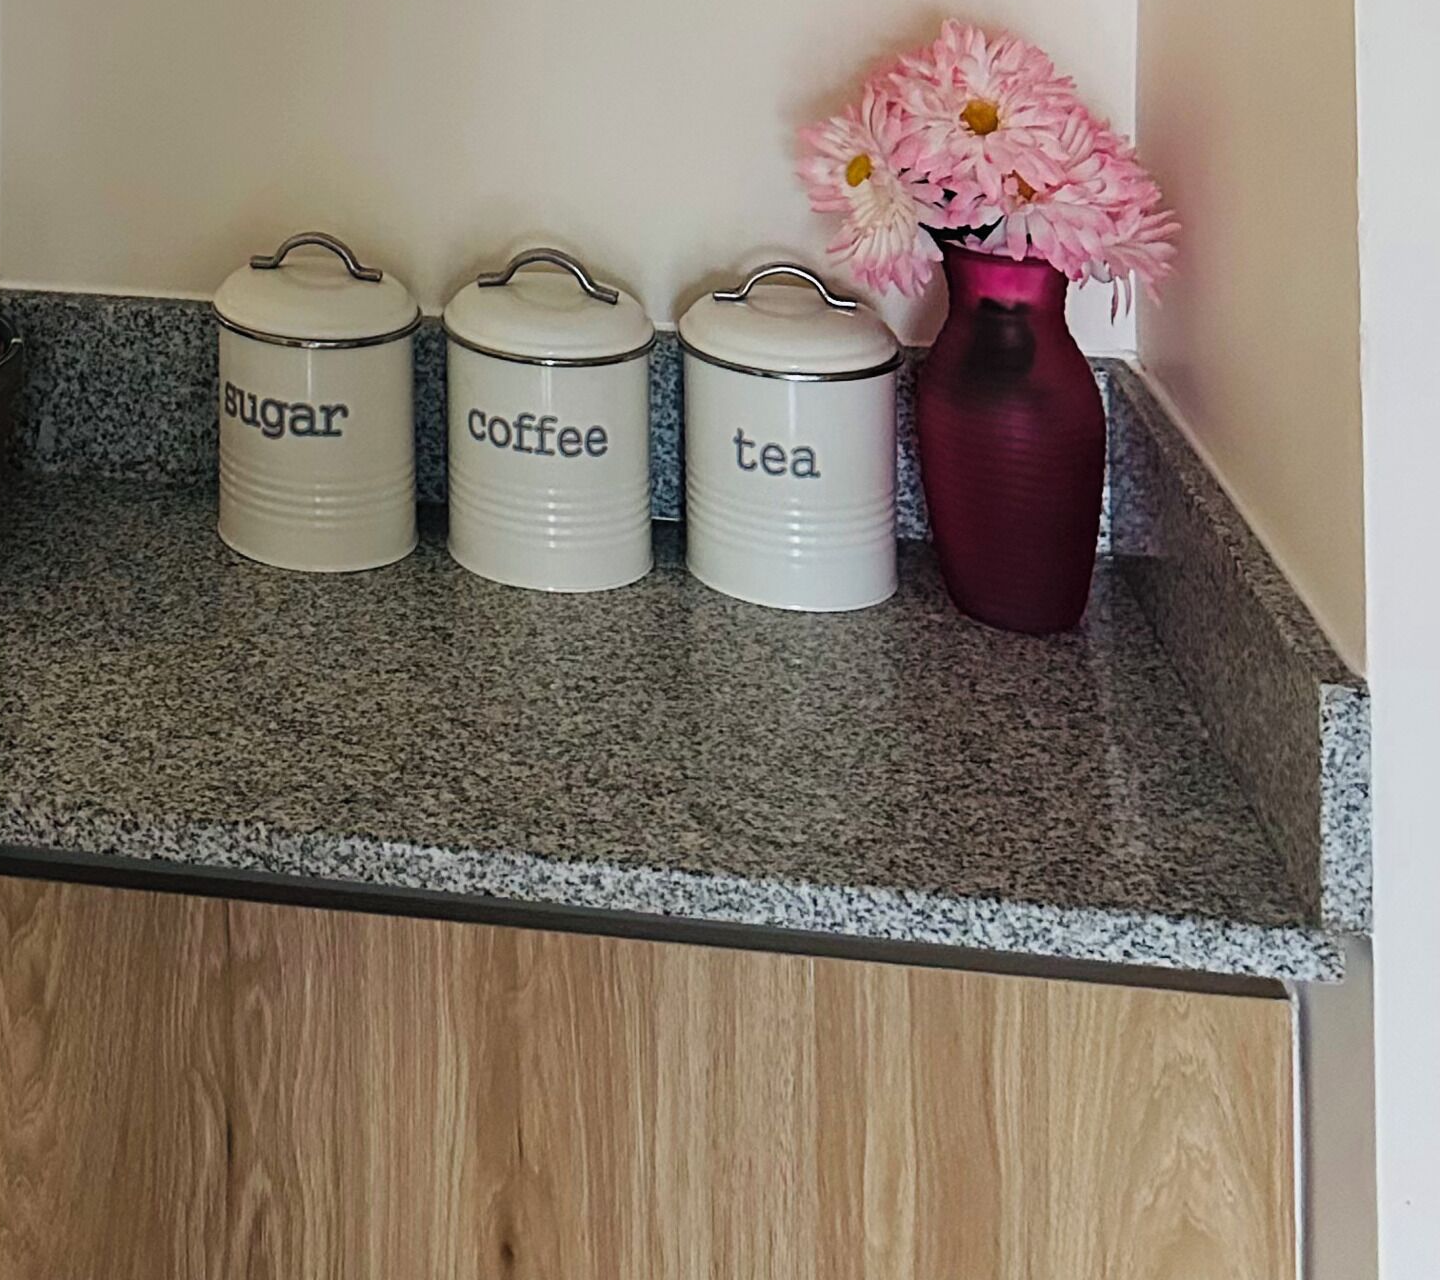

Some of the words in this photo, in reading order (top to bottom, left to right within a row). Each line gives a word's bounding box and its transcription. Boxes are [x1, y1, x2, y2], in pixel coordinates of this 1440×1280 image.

[224, 381, 349, 439] sugar
[467, 408, 609, 458] coffee
[732, 427, 821, 479] tea
